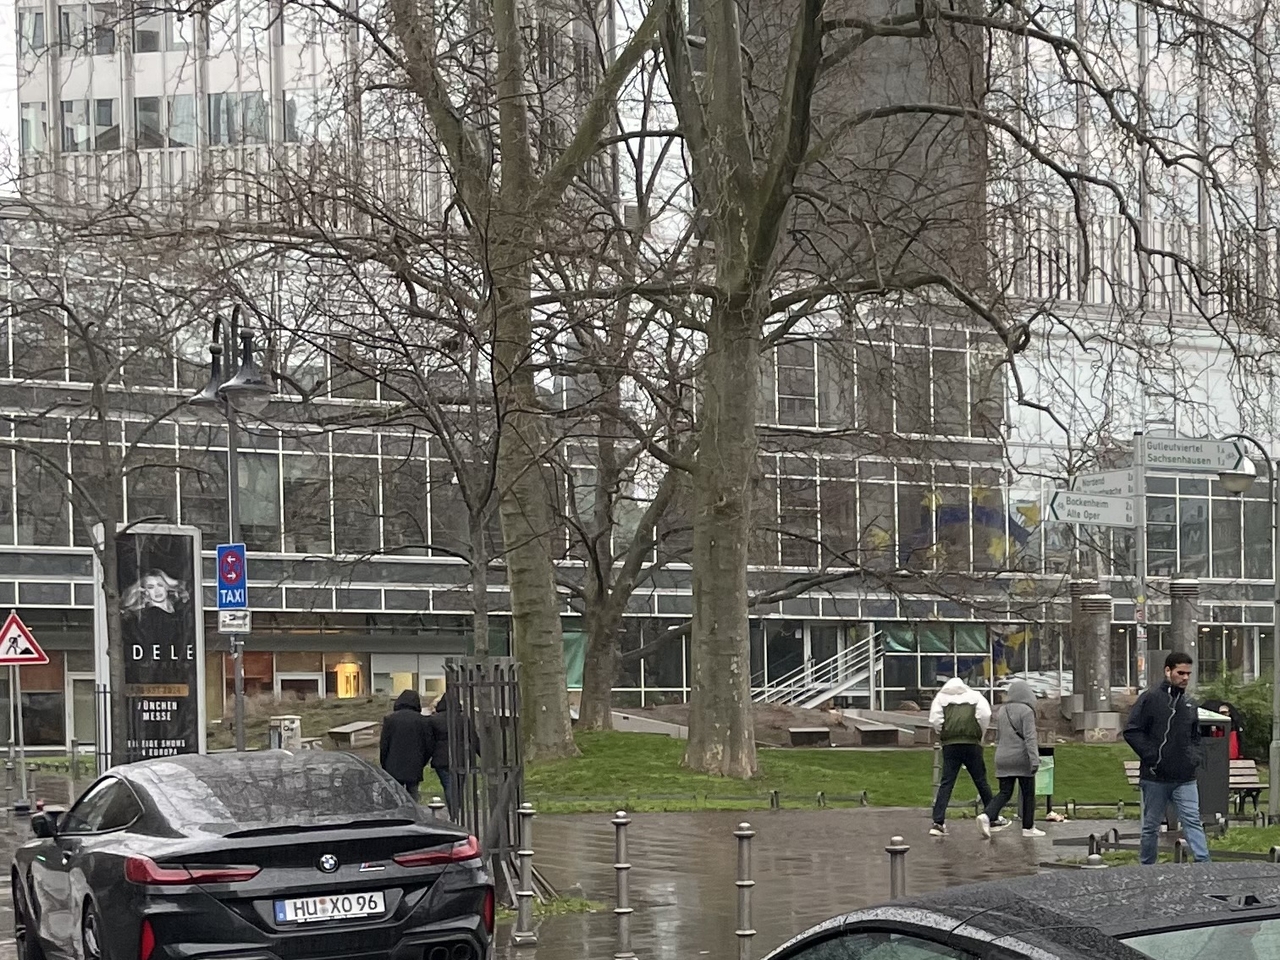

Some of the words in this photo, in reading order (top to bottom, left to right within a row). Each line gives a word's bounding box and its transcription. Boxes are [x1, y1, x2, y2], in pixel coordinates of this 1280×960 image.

[1147, 442, 1203, 453] Gutleutviertel
[1147, 454, 1211, 465] Sachsenhausen
[1066, 496, 1108, 508] Bockenheim
[1067, 509, 1080, 518] Alte
[1084, 510, 1100, 521] Oper
[220, 589, 244, 604] TAXI
[132, 644, 194, 660] DELE
[142, 711, 171, 721] MESSE
[161, 740, 186, 748] SHOWS
[149, 748, 178, 756] EUROPA
[293, 899, 318, 917] HU
[330, 896, 352, 914] XO
[356, 894, 378, 911] 96
